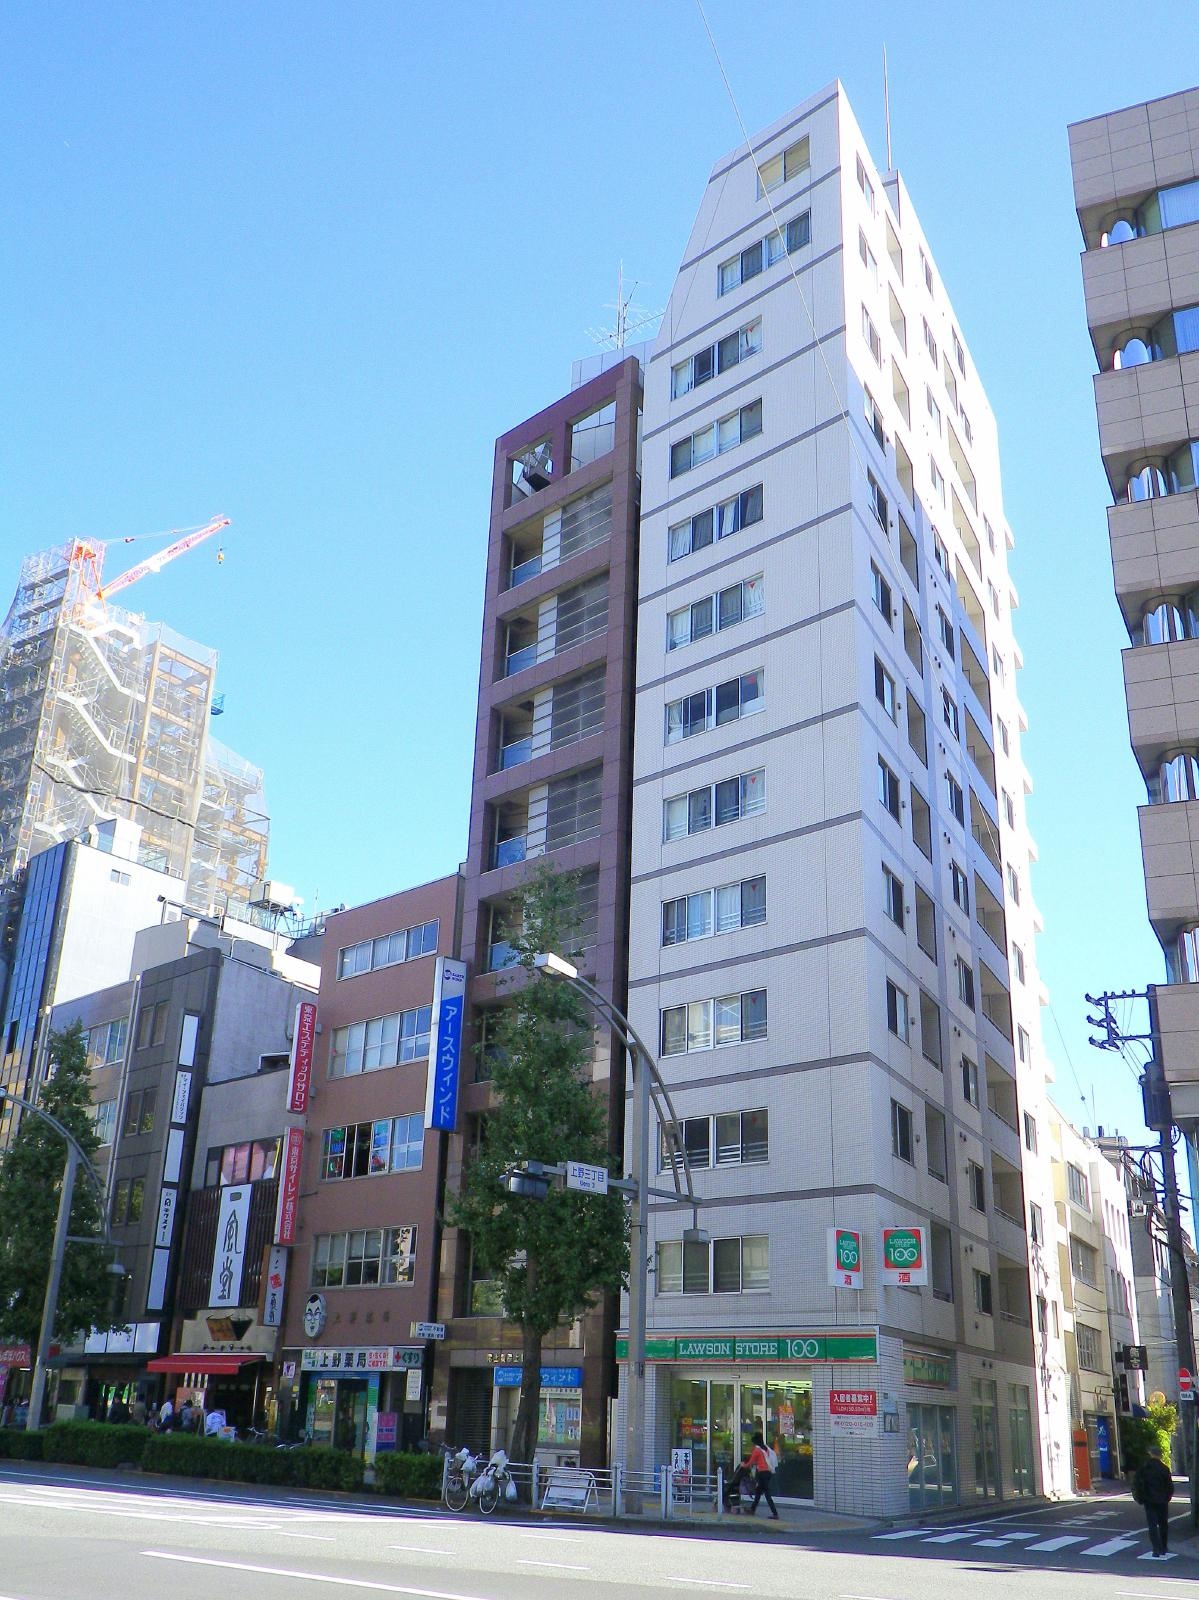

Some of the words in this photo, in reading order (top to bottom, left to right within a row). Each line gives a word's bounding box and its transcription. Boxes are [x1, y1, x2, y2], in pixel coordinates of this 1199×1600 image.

[440, 1005, 457, 1125] アースウィンド
[571, 1165, 604, 1182] 上野三丁目
[840, 1249, 858, 1264] 100
[889, 1248, 918, 1261] 100
[844, 1274, 852, 1286] 酒
[898, 1272, 911, 1283] 酒
[680, 1343, 730, 1355] LAWSON
[735, 1343, 778, 1355] STORE
[785, 1339, 819, 1358] 100
[320, 1352, 367, 1369] 上野薬局
[402, 1352, 420, 1364] くすり
